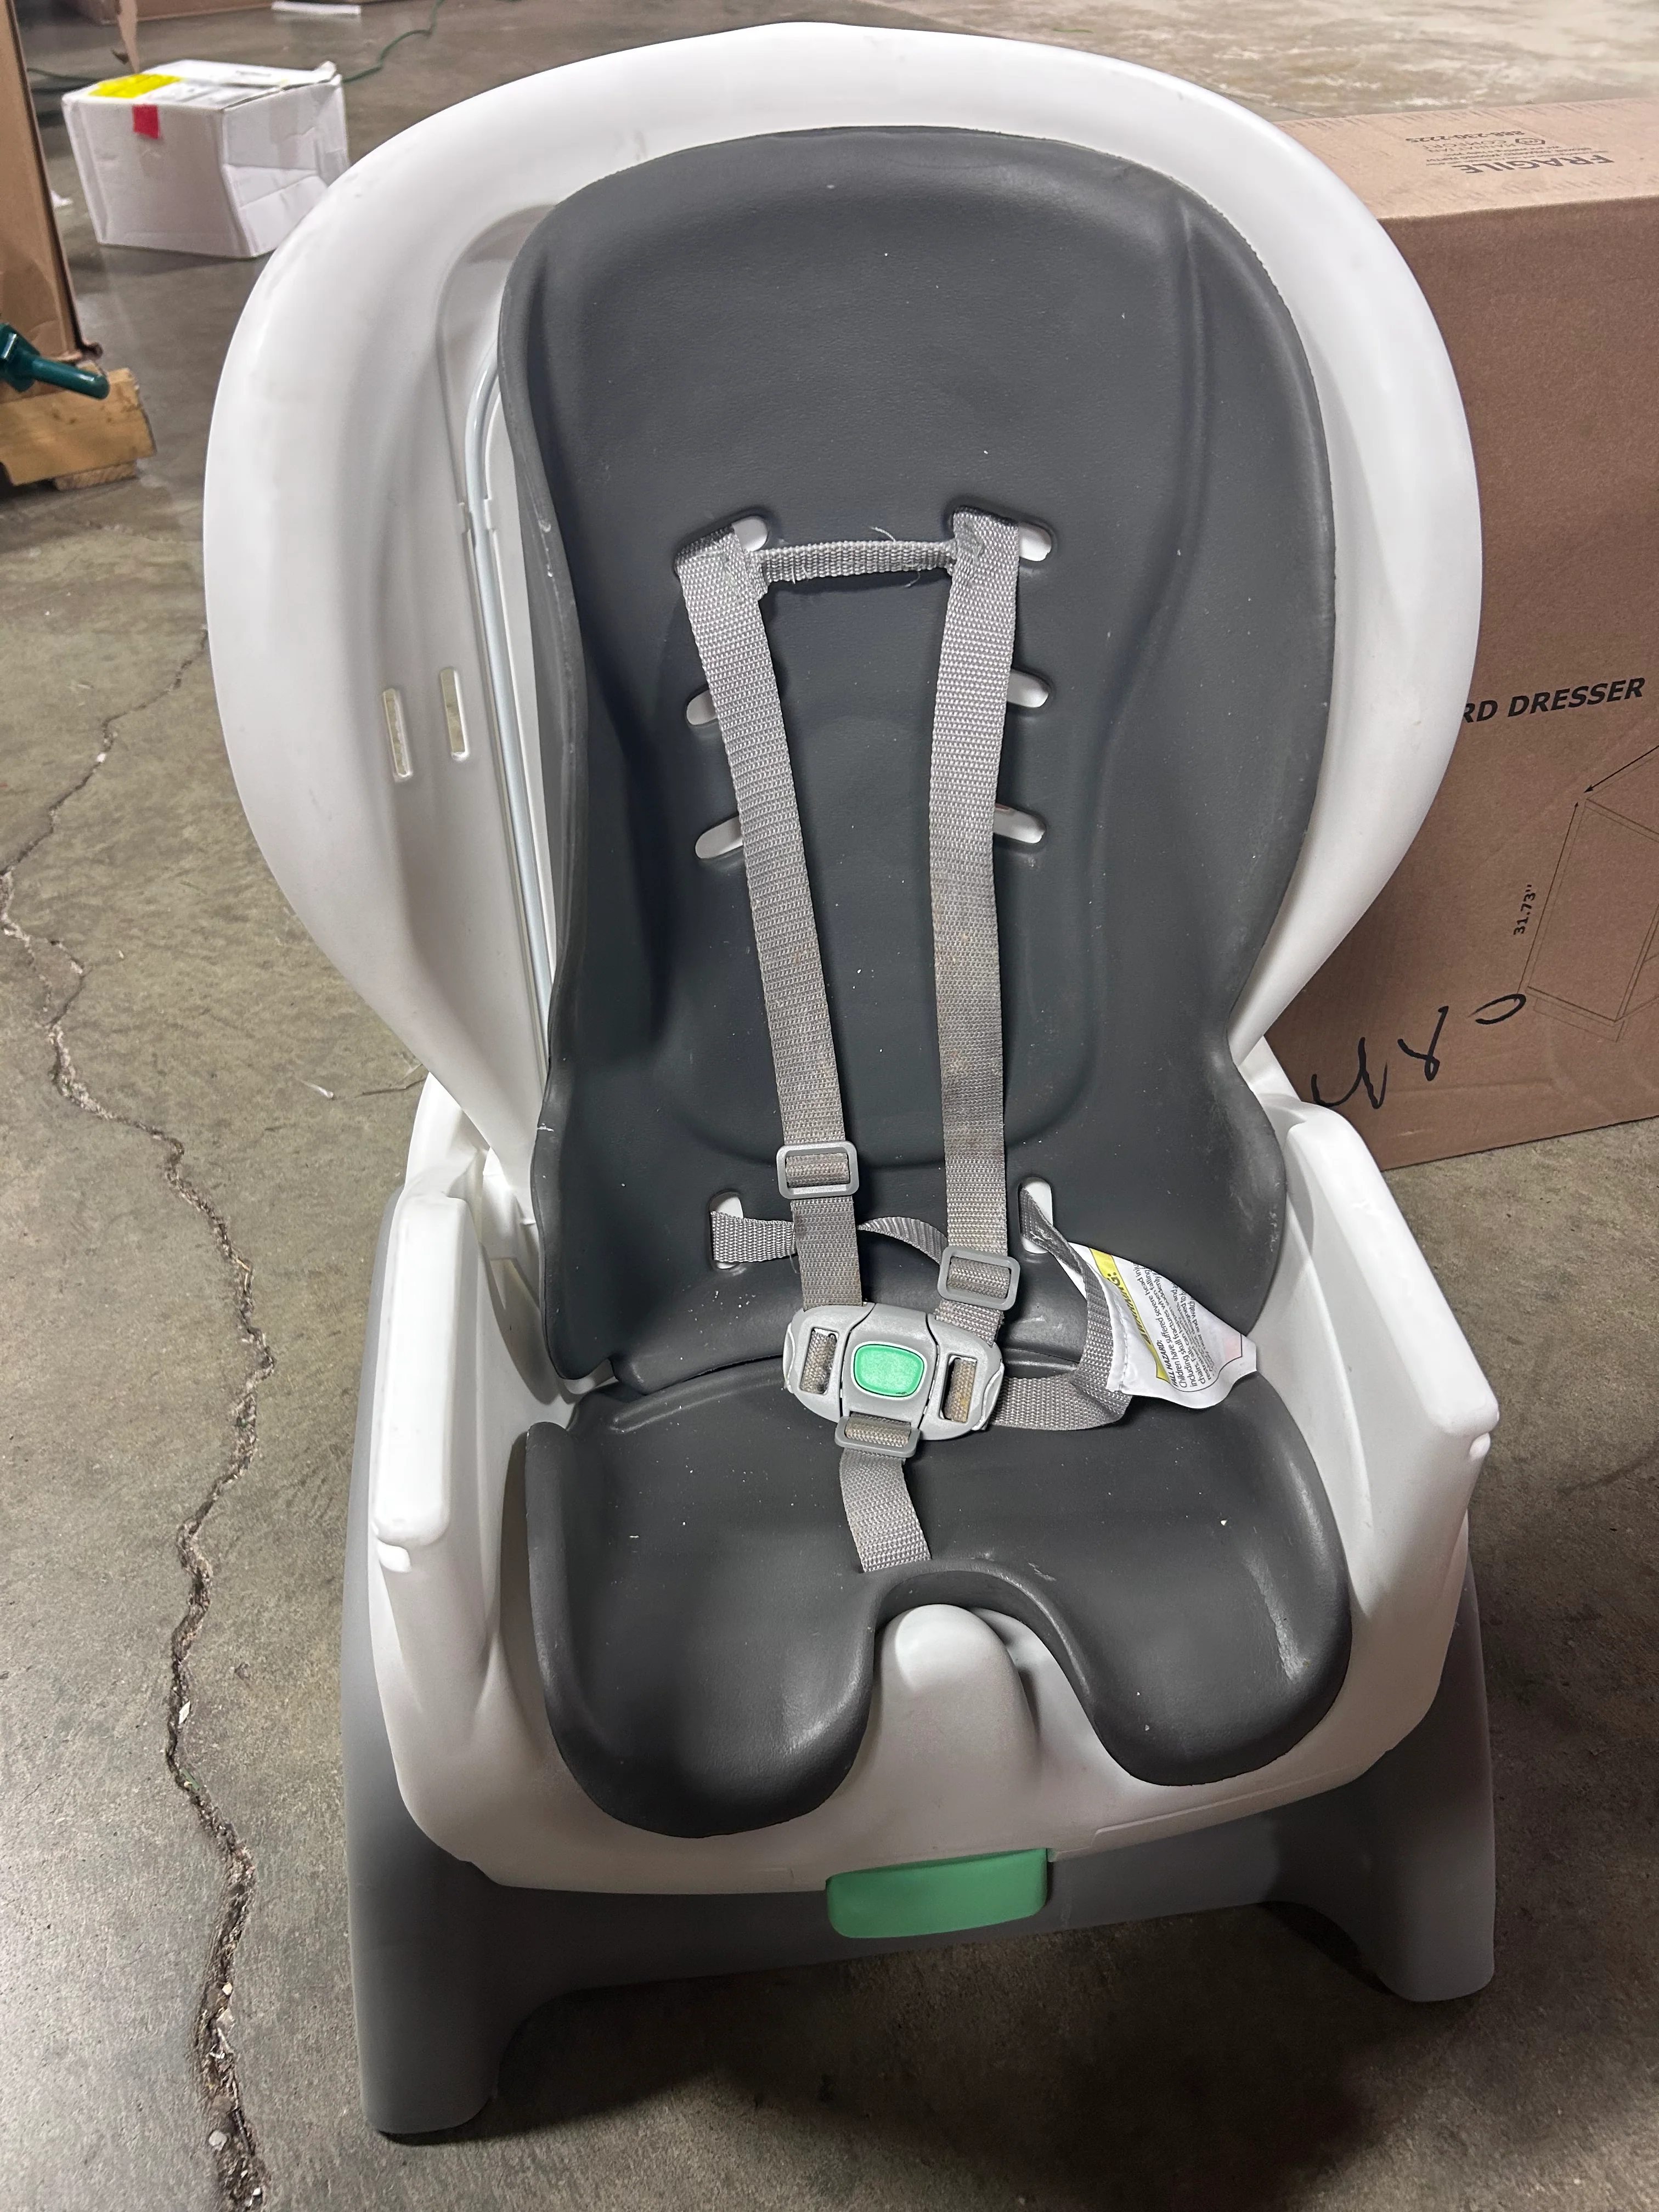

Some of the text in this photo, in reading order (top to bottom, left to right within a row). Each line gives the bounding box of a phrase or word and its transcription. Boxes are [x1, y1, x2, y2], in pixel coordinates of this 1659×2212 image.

[1423, 139, 1506, 149] COMFORT
[1451, 154, 1615, 174] FRAGILE
[1508, 677, 1645, 717] DRESSER
[1137, 1277, 1150, 1295] head
[1144, 1269, 1155, 1290] falling
[1153, 1276, 1170, 1306] suddenly
[1153, 1290, 1166, 1310] when
[1170, 1289, 1178, 1302] and
[1148, 1295, 1162, 1317] severe
[1155, 1317, 1173, 1344] suffered
[1164, 1309, 1180, 1340] fractures
[1169, 1307, 1183, 1334] happen
[1192, 1318, 1200, 1333] and
[1169, 1344, 1179, 1360] have
[1175, 1339, 1187, 1355] skull
[1156, 1339, 1179, 1387] FALL HAZARD:
[1183, 1355, 1198, 1387] including
[1192, 1346, 1212, 1381] restrained
[1175, 1361, 1188, 1388] Children
